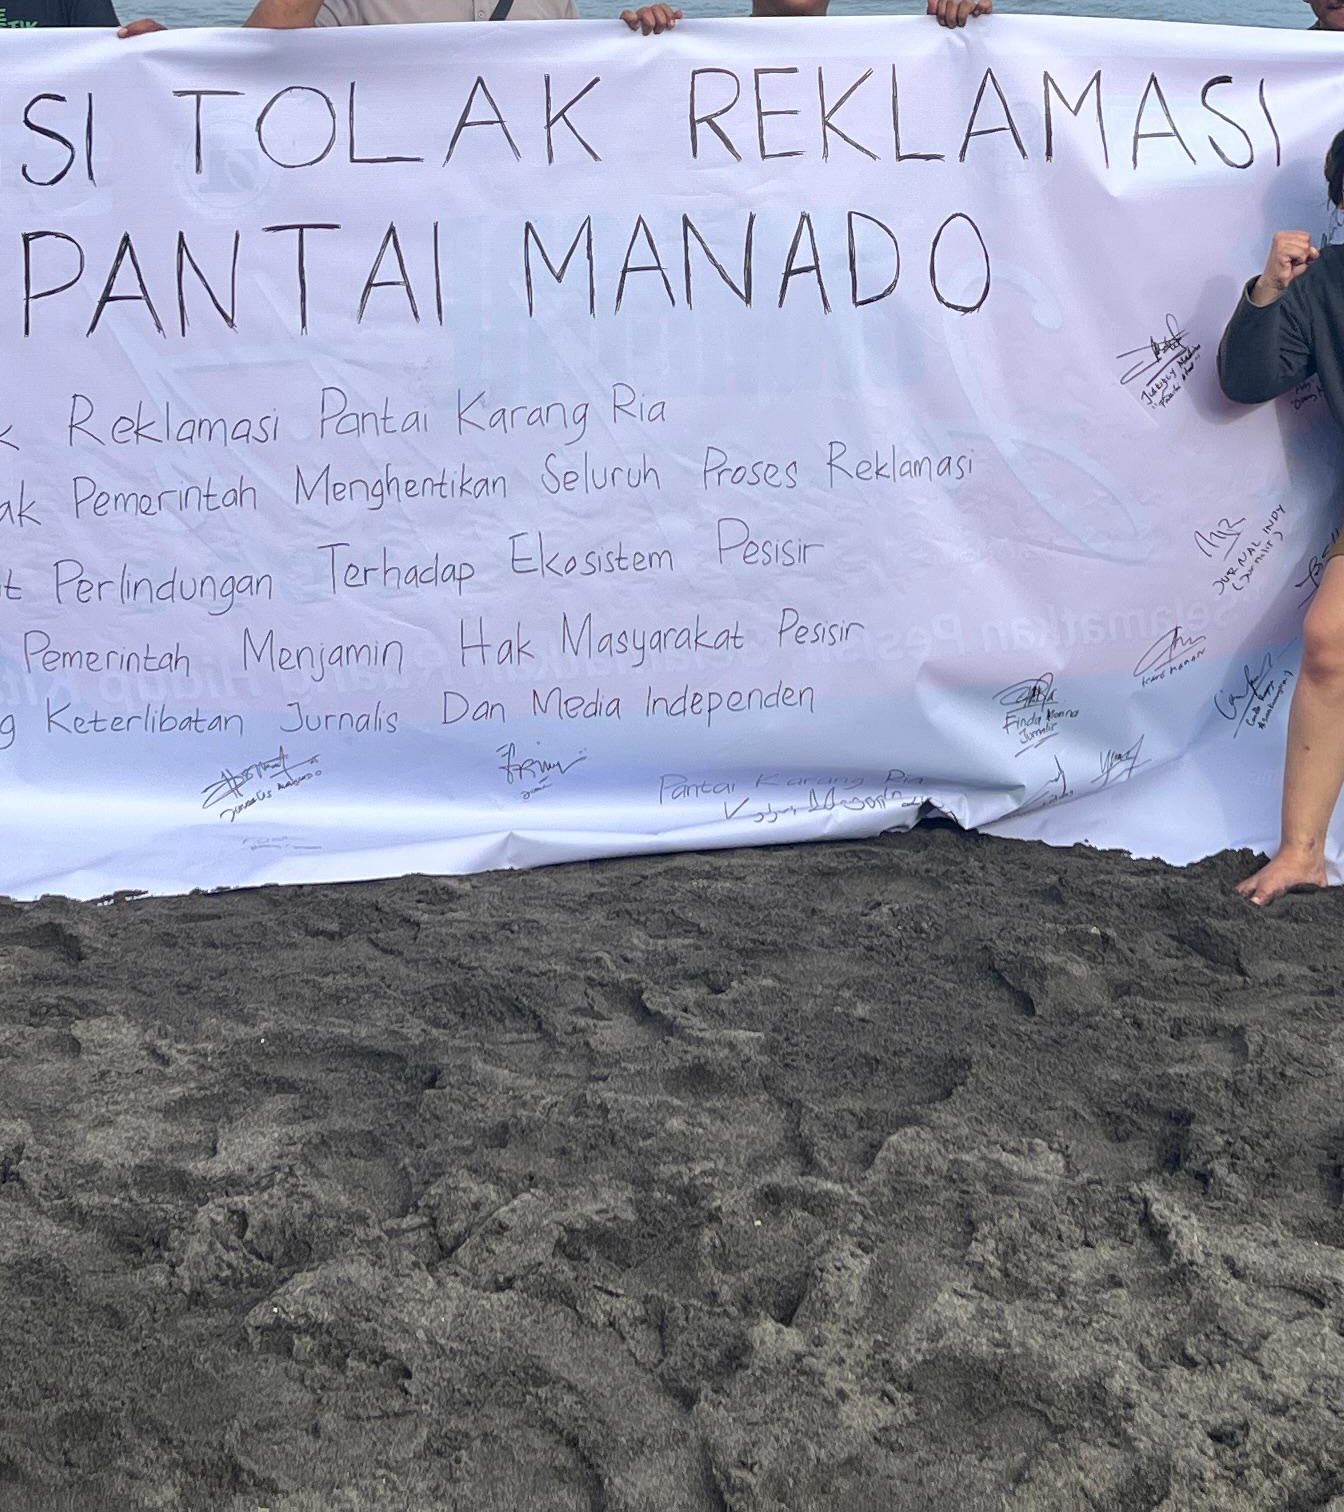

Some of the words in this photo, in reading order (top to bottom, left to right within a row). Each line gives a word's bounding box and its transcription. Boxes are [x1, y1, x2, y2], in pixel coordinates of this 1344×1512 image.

[172, 74, 603, 175] TOLAK
[689, 63, 1287, 170] REKLAMASI
[21, 221, 442, 339] PANTAI
[524, 211, 990, 318] MANADO
[68, 393, 278, 446] Reklamasi
[321, 387, 427, 439] Pantai
[458, 389, 589, 445] Karang
[613, 383, 665, 423] Ria
[73, 475, 256, 518] Pemerintah
[296, 463, 506, 510] Menghentikan
[541, 451, 660, 494] Seluruh
[704, 446, 797, 490] Proses
[827, 441, 971, 488] Reklamasi
[53, 559, 272, 616] Perlindungan
[317, 543, 474, 596] Terhadap
[509, 531, 673, 577] Ekosistem
[718, 518, 824, 566] Pesisir
[1212, 540, 1262, 596] JURNAL
[1262, 504, 1286, 534] INDY
[24, 630, 189, 677] Pemerintah
[244, 627, 403, 682] Menjamin
[461, 616, 535, 667] Hak
[563, 612, 744, 668] Masyarakat
[778, 608, 864, 647] Pesisir
[47, 698, 243, 736] Keterlibatan
[280, 701, 397, 733] Jurnalis
[442, 691, 505, 724] Dan
[533, 687, 620, 720] Media
[646, 680, 813, 721] Independen
[1003, 711, 1042, 734] Finda
[659, 773, 736, 805] Pantai
[755, 773, 865, 789] Karang
[886, 768, 924, 785] Ria
